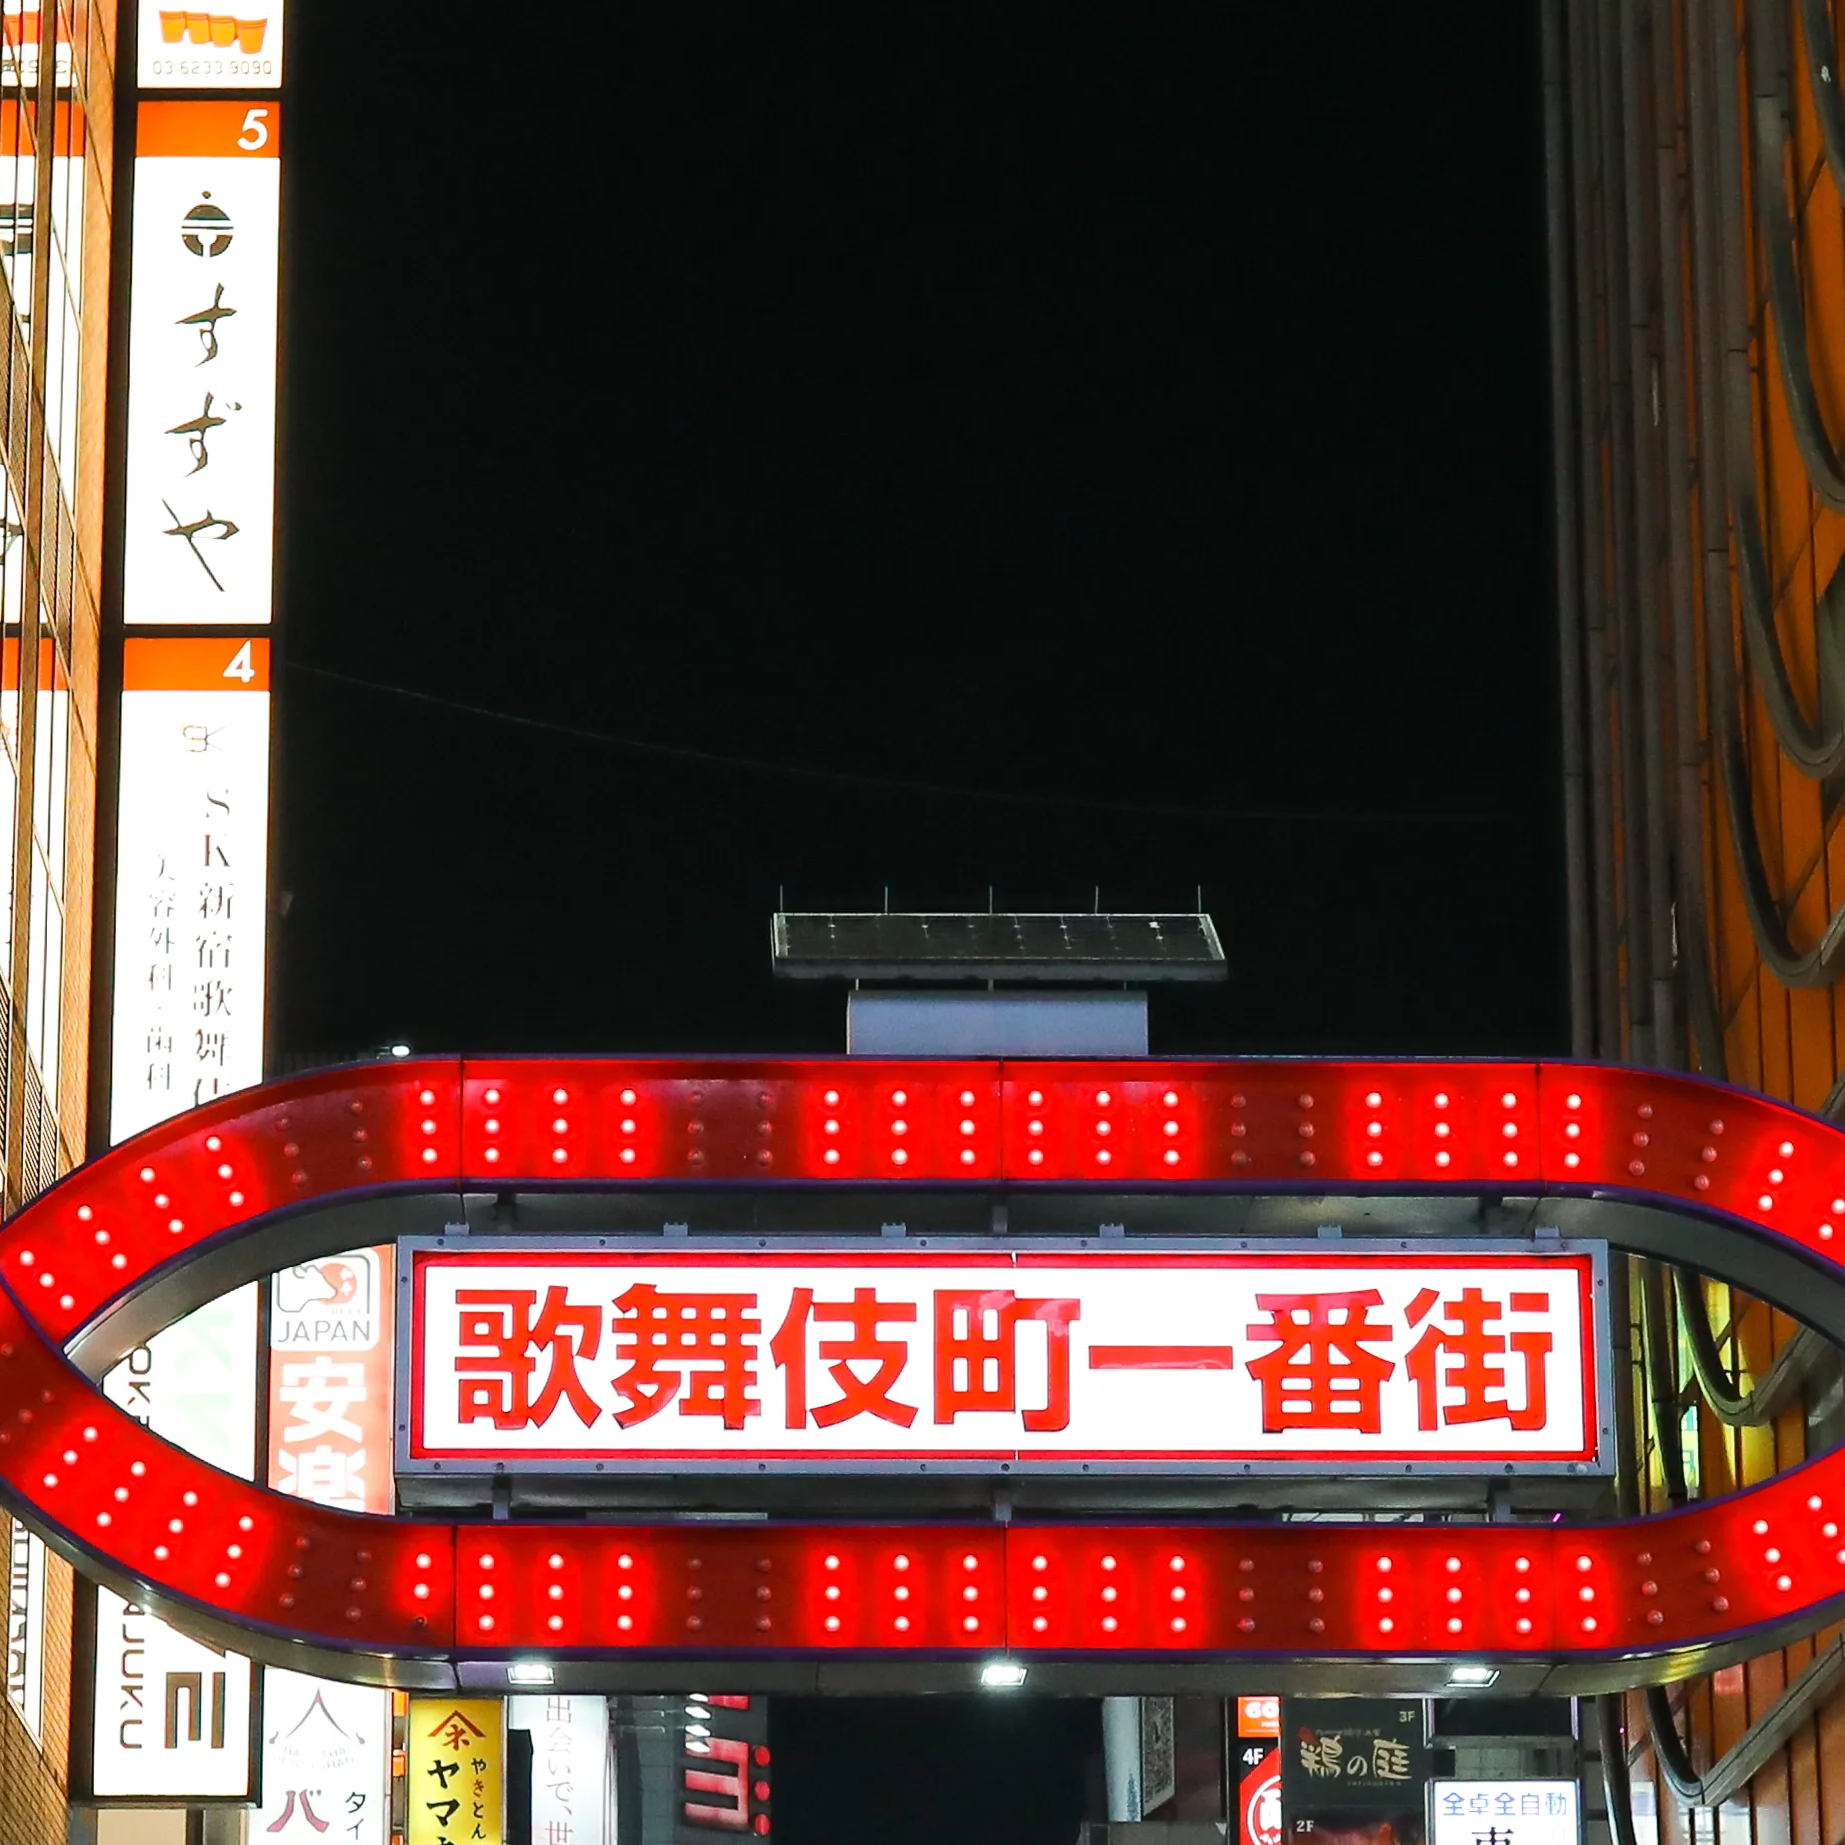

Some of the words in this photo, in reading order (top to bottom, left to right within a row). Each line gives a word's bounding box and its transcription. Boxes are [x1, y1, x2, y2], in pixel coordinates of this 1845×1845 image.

[153, 59, 174, 76] 03
[180, 59, 223, 76] 6233
[230, 59, 272, 76] 9090
[237, 108, 268, 150] 5
[223, 640, 256, 683] 4
[277, 1320, 372, 1344] JAPAN
[453, 1282, 1554, 1436] 歌舞伎町一番街
[1398, 1710, 1416, 1723] 3F
[1242, 1747, 1264, 1766] 4F
[1442, 1791, 1568, 1818] 全卓全自動
[1296, 1820, 1315, 1832] 2F
